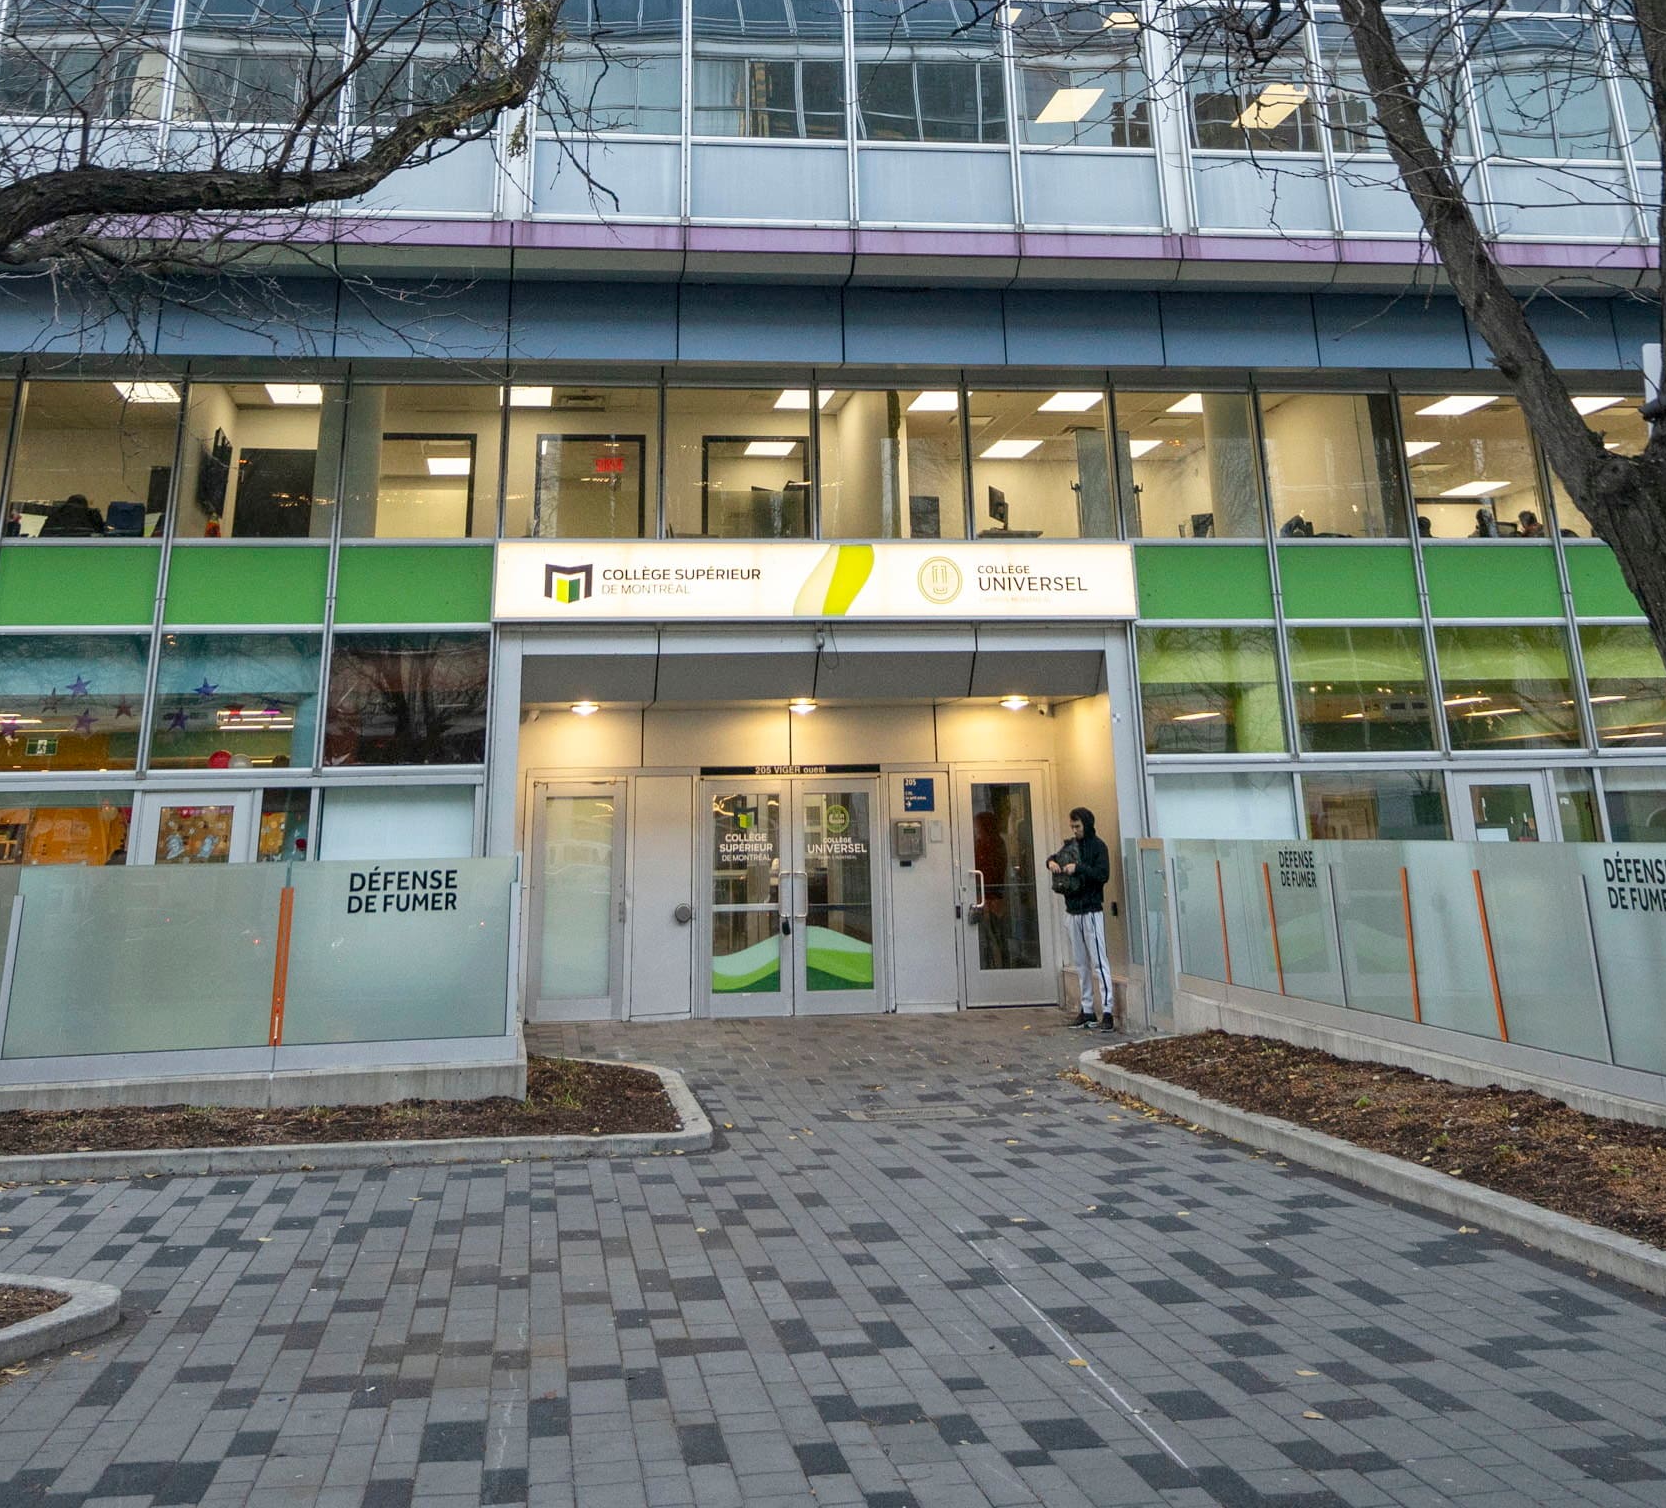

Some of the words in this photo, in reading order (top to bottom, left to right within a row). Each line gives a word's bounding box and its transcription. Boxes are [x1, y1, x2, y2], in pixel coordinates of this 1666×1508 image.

[602, 565, 670, 580] COLLÈGE
[675, 565, 761, 580] SUPÉRIEUR
[977, 563, 1030, 574] COLLÈGE
[602, 584, 618, 594] DE
[978, 576, 1088, 591] UNIVERSEL
[755, 766, 772, 774] 205
[774, 765, 800, 774] VIGER
[803, 765, 827, 774] ouest
[905, 778, 917, 786] 205
[719, 841, 773, 852] SUPÉRIEUR
[807, 843, 867, 853] UNIVERSEL
[1278, 846, 1314, 868] DÉFENSE
[349, 866, 458, 892] DÉFENSE
[1281, 871, 1291, 886] DE
[1291, 871, 1317, 888] FUMER
[347, 895, 377, 914] DE
[383, 892, 457, 912] FUMER
[1607, 886, 1629, 910] DE
